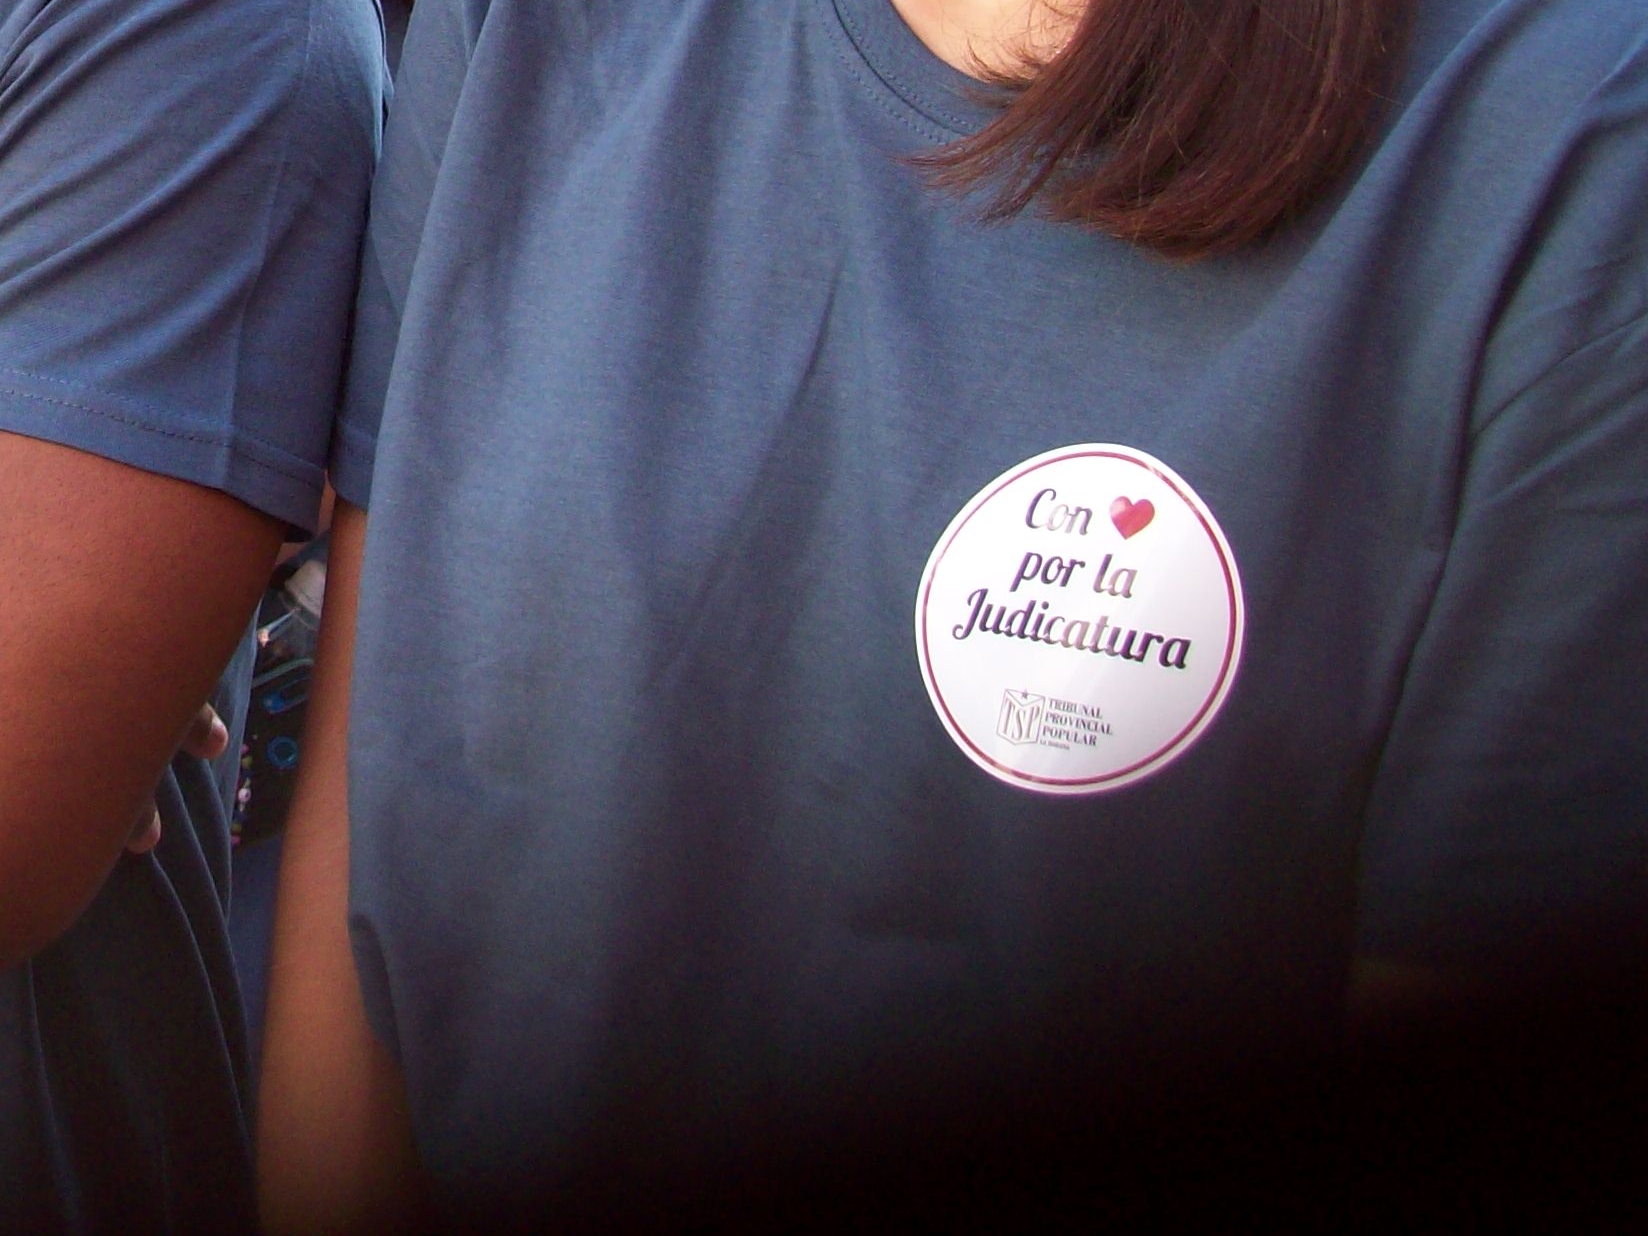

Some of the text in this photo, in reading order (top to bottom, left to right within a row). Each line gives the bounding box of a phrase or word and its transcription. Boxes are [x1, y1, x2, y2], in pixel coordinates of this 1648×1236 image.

[1025, 488, 1093, 536] Con
[1009, 552, 1138, 599] por la
[952, 588, 1192, 670] Judicatura
[1044, 711, 1113, 735] PROVINCIAL
[1048, 697, 1103, 720] TRIBUNAL
[1042, 724, 1098, 746] POPULAR
